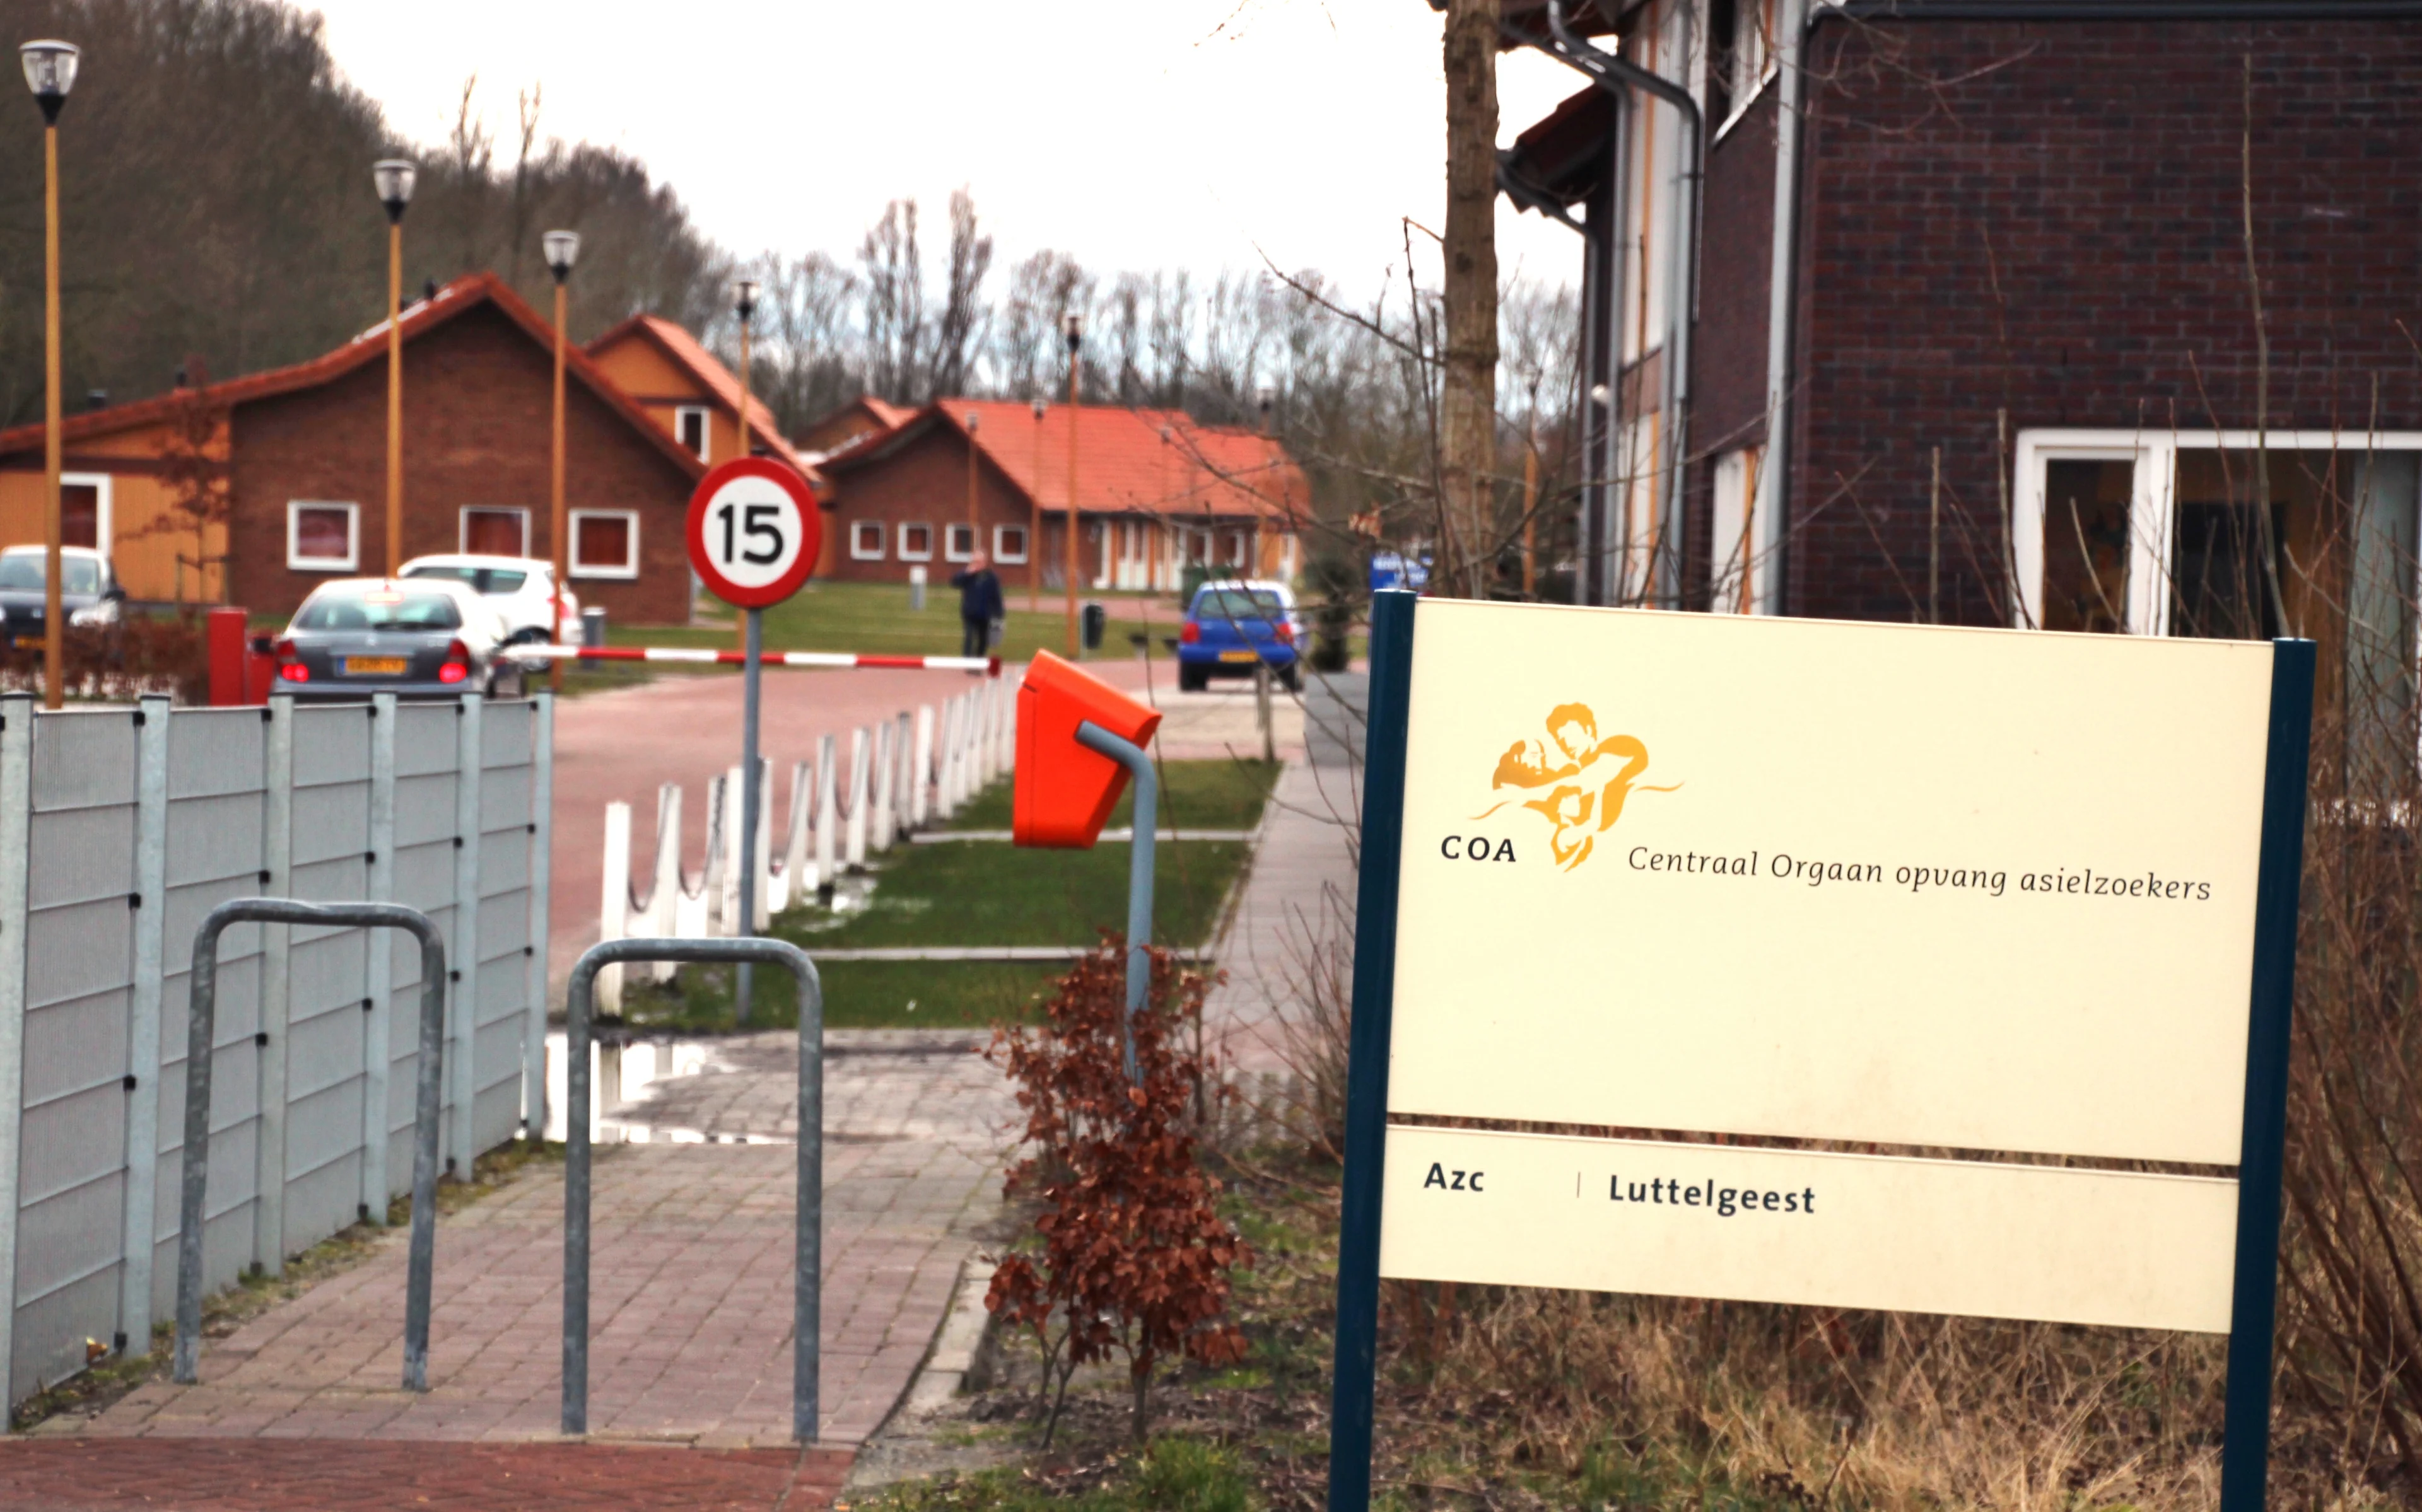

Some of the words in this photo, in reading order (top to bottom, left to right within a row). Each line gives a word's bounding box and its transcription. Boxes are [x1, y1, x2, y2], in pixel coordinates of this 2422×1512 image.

[718, 504, 784, 565] 15
[1441, 835, 1517, 863] COA
[1628, 846, 1758, 876] Centraal
[1770, 854, 1882, 888] Orgaan
[1895, 866, 2007, 897] opvang
[2020, 866, 2211, 901] asielzoekers
[1424, 1162, 1485, 1192] Azc
[1610, 1174, 1816, 1218] Luttelgeest
